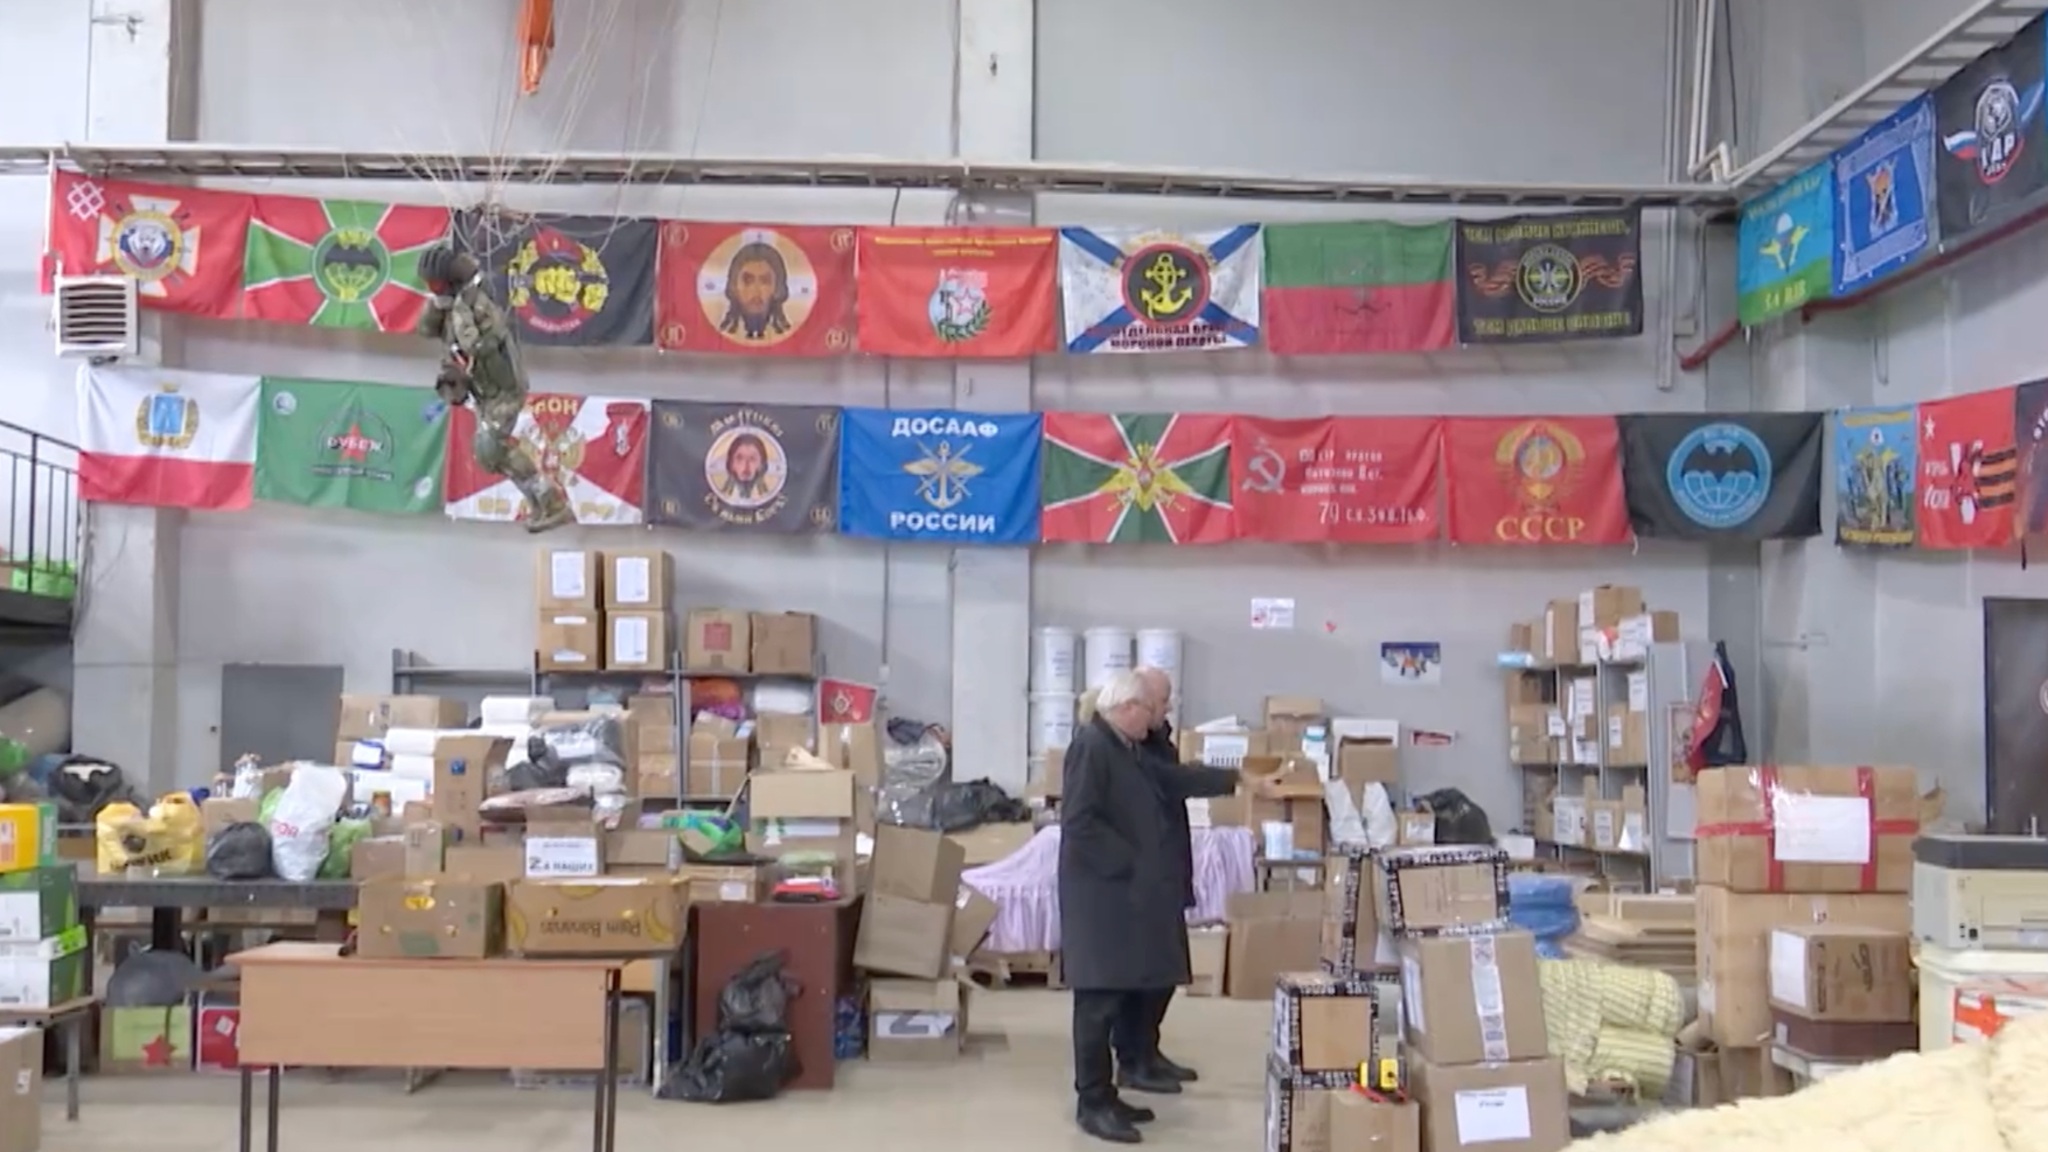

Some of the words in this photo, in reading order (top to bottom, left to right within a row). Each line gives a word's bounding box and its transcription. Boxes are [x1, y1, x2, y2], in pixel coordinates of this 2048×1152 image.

[891, 415, 999, 438] ДОСААФ
[889, 511, 996, 534] РОССИИ
[1319, 501, 1340, 525] 79
[1495, 515, 1585, 541] СССР
